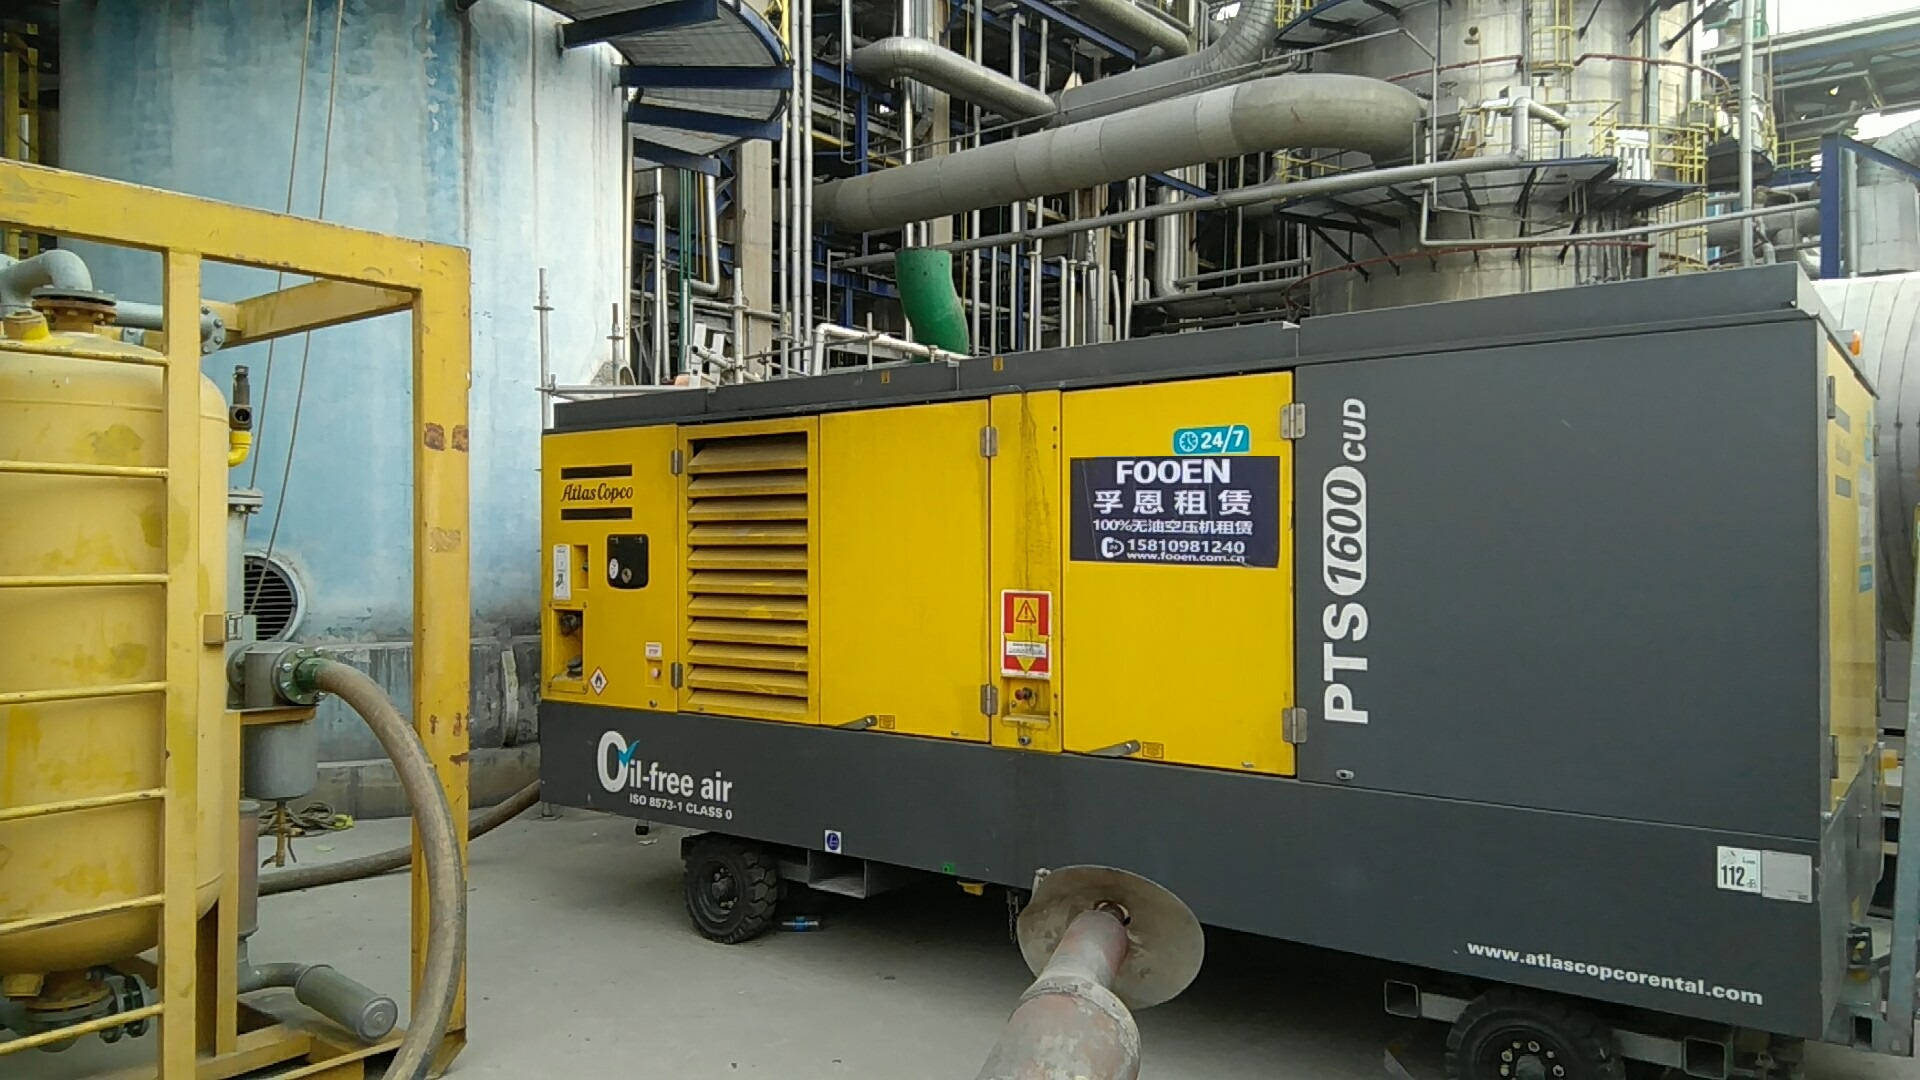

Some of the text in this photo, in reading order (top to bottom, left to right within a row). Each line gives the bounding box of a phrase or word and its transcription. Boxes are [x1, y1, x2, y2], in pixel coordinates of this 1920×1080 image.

[1200, 425, 1244, 453] 24/7
[1116, 458, 1231, 485] FOOEN
[560, 482, 634, 503] Atlas Copco
[1093, 489, 1253, 516] 孚恩租赁
[1126, 551, 1246, 563] www.fooen.com.cn
[1127, 538, 1246, 554] 15810981240
[1322, 398, 1369, 725] PTS 1600 CUD
[700, 771, 733, 803] air
[629, 792, 733, 821] ISO 8573-1 CLASS 0
[1720, 865, 1745, 887] 112
[1466, 942, 1764, 1006] www.atlascopcorental.com
